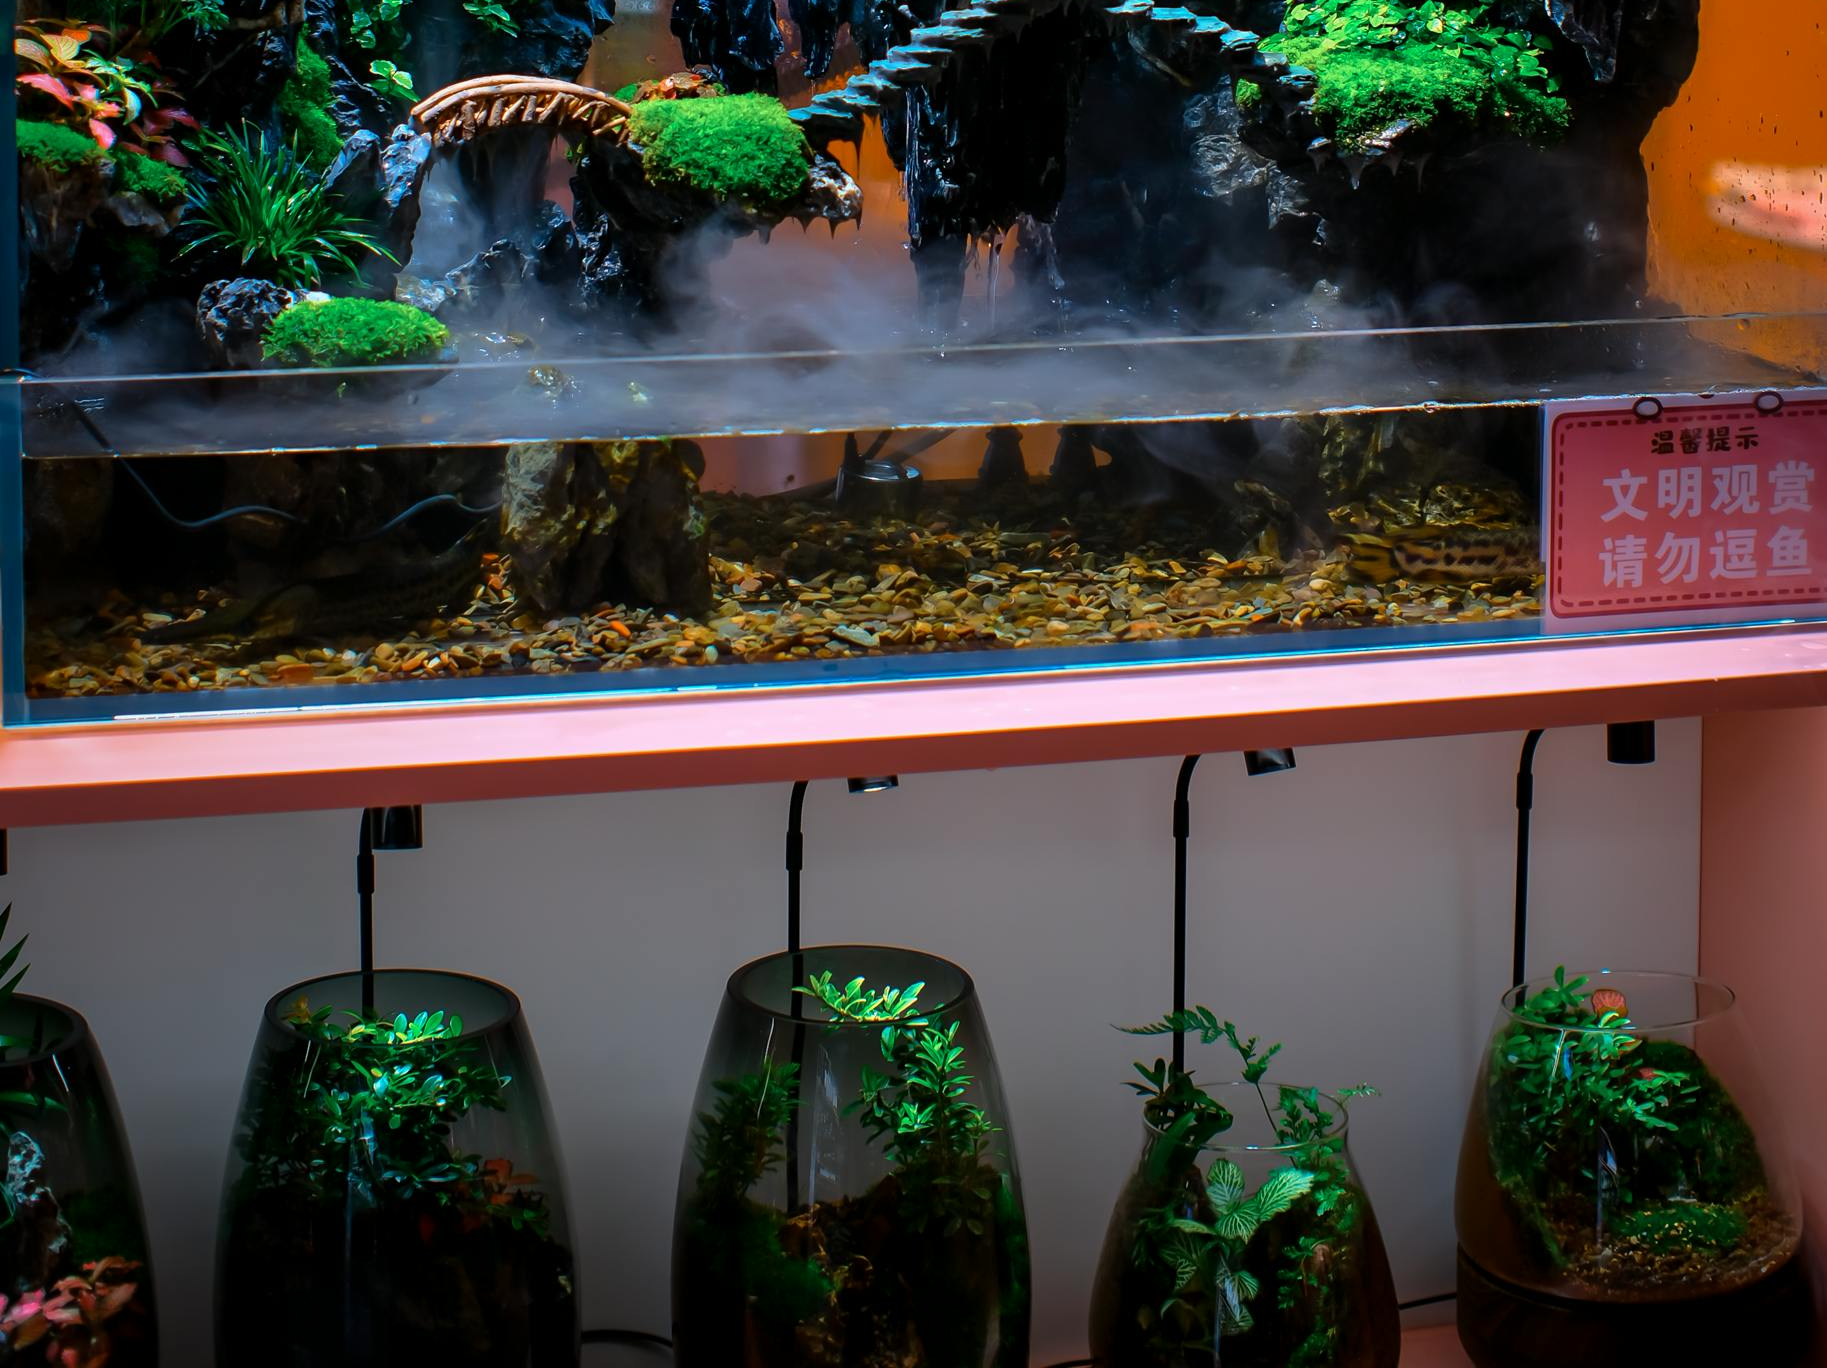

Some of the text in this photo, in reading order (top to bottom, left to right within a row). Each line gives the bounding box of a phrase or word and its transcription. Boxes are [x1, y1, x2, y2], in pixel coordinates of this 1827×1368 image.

[1652, 426, 1759, 454] 温馨提示
[1600, 460, 1815, 522] 文明观赏
[1598, 525, 1812, 589] 请勿逗鱼
